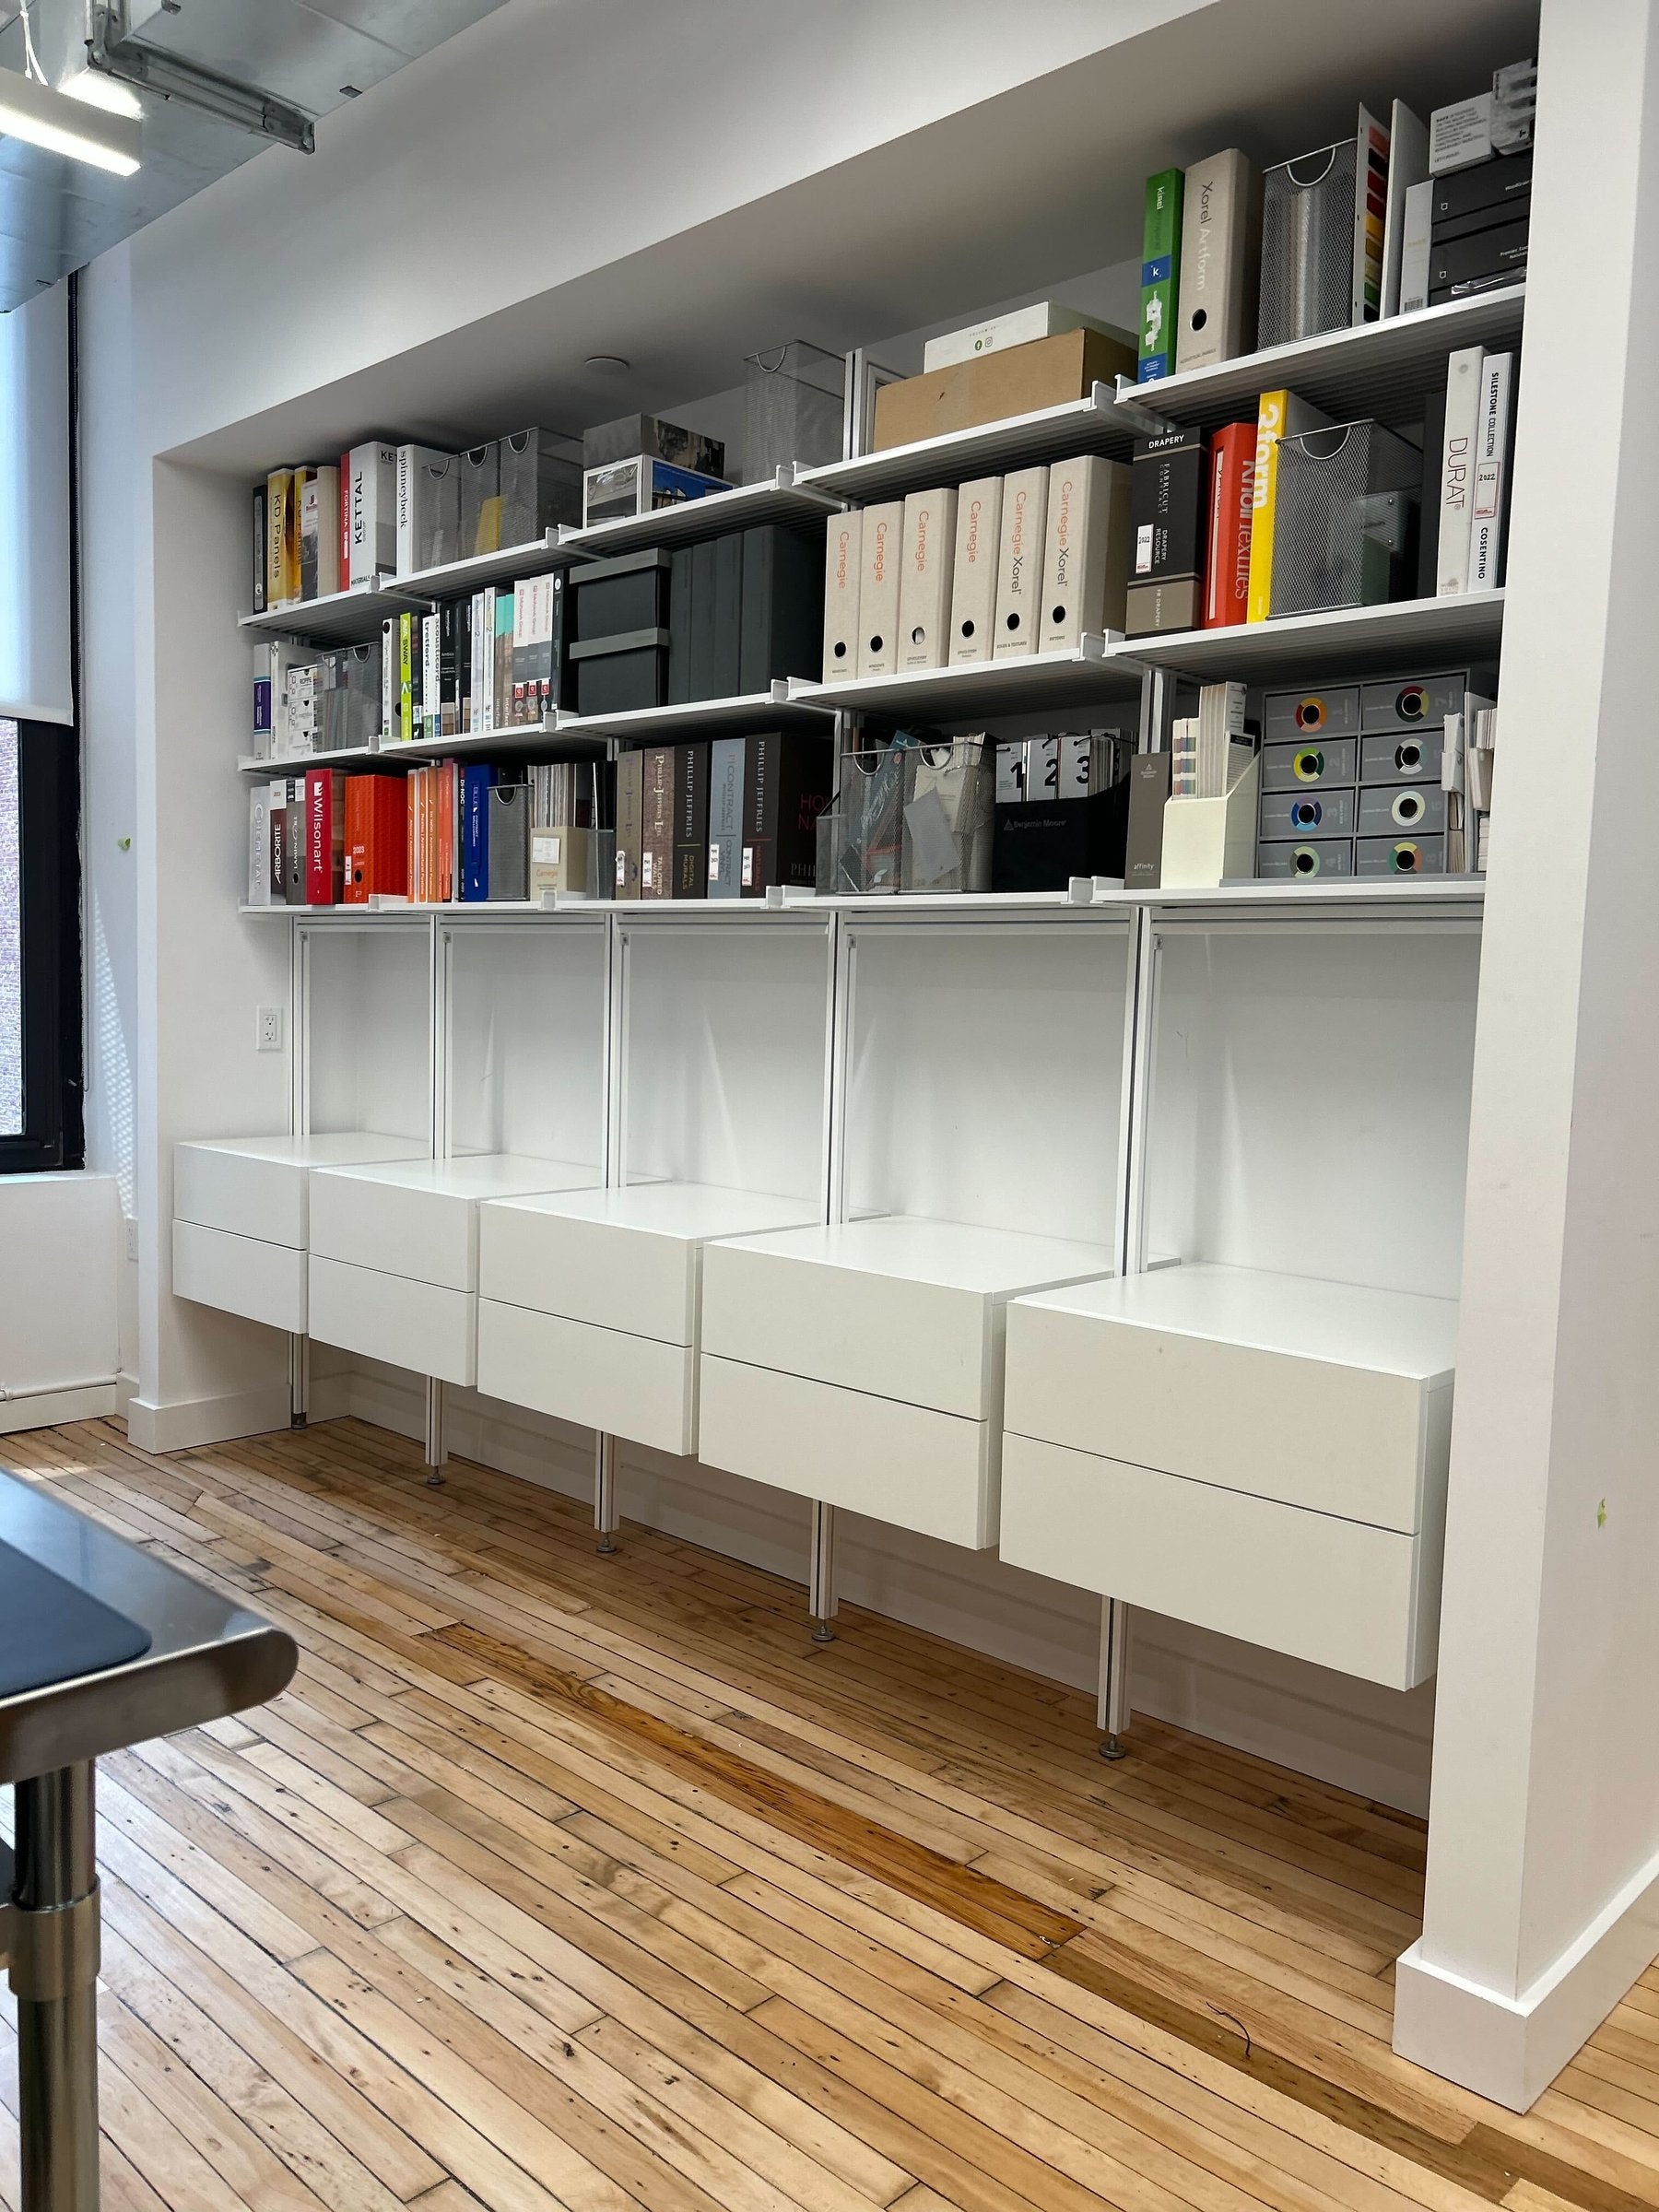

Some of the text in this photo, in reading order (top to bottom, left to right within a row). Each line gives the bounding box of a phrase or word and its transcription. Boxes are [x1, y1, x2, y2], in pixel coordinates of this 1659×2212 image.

[1196, 181, 1213, 291] Xorel Artform
[1148, 434, 1184, 449] DRAPERY
[1486, 371, 1500, 457] SILESTONE COLLECTION
[274, 494, 281, 518] KD
[399, 451, 408, 529] spinneybeck
[1162, 463, 1171, 514] FABRICUT
[1478, 473, 1496, 482] 2022
[354, 471, 363, 545] KETTAL
[967, 500, 981, 563] Carnegie
[1011, 491, 1027, 555] Carnegie
[1057, 481, 1073, 547] Carnegie
[837, 531, 850, 589] Carnegie
[874, 522, 888, 582] Carnegie
[915, 511, 929, 571] Carnegie
[1138, 536, 1150, 545] 2022
[1477, 527, 1488, 580] COSENTINO
[686, 750, 694, 792] PHILLIP
[726, 765, 735, 830] CONTRACT
[756, 741, 766, 832] PHILLIP JEFFRIES
[1010, 761, 1023, 789] 1
[1044, 759, 1057, 786] 2
[1076, 755, 1089, 784] 3
[313, 797, 323, 872] Wilsonart
[1014, 819, 1042, 829] Benjamin
[1134, 862, 1154, 871] affinity
